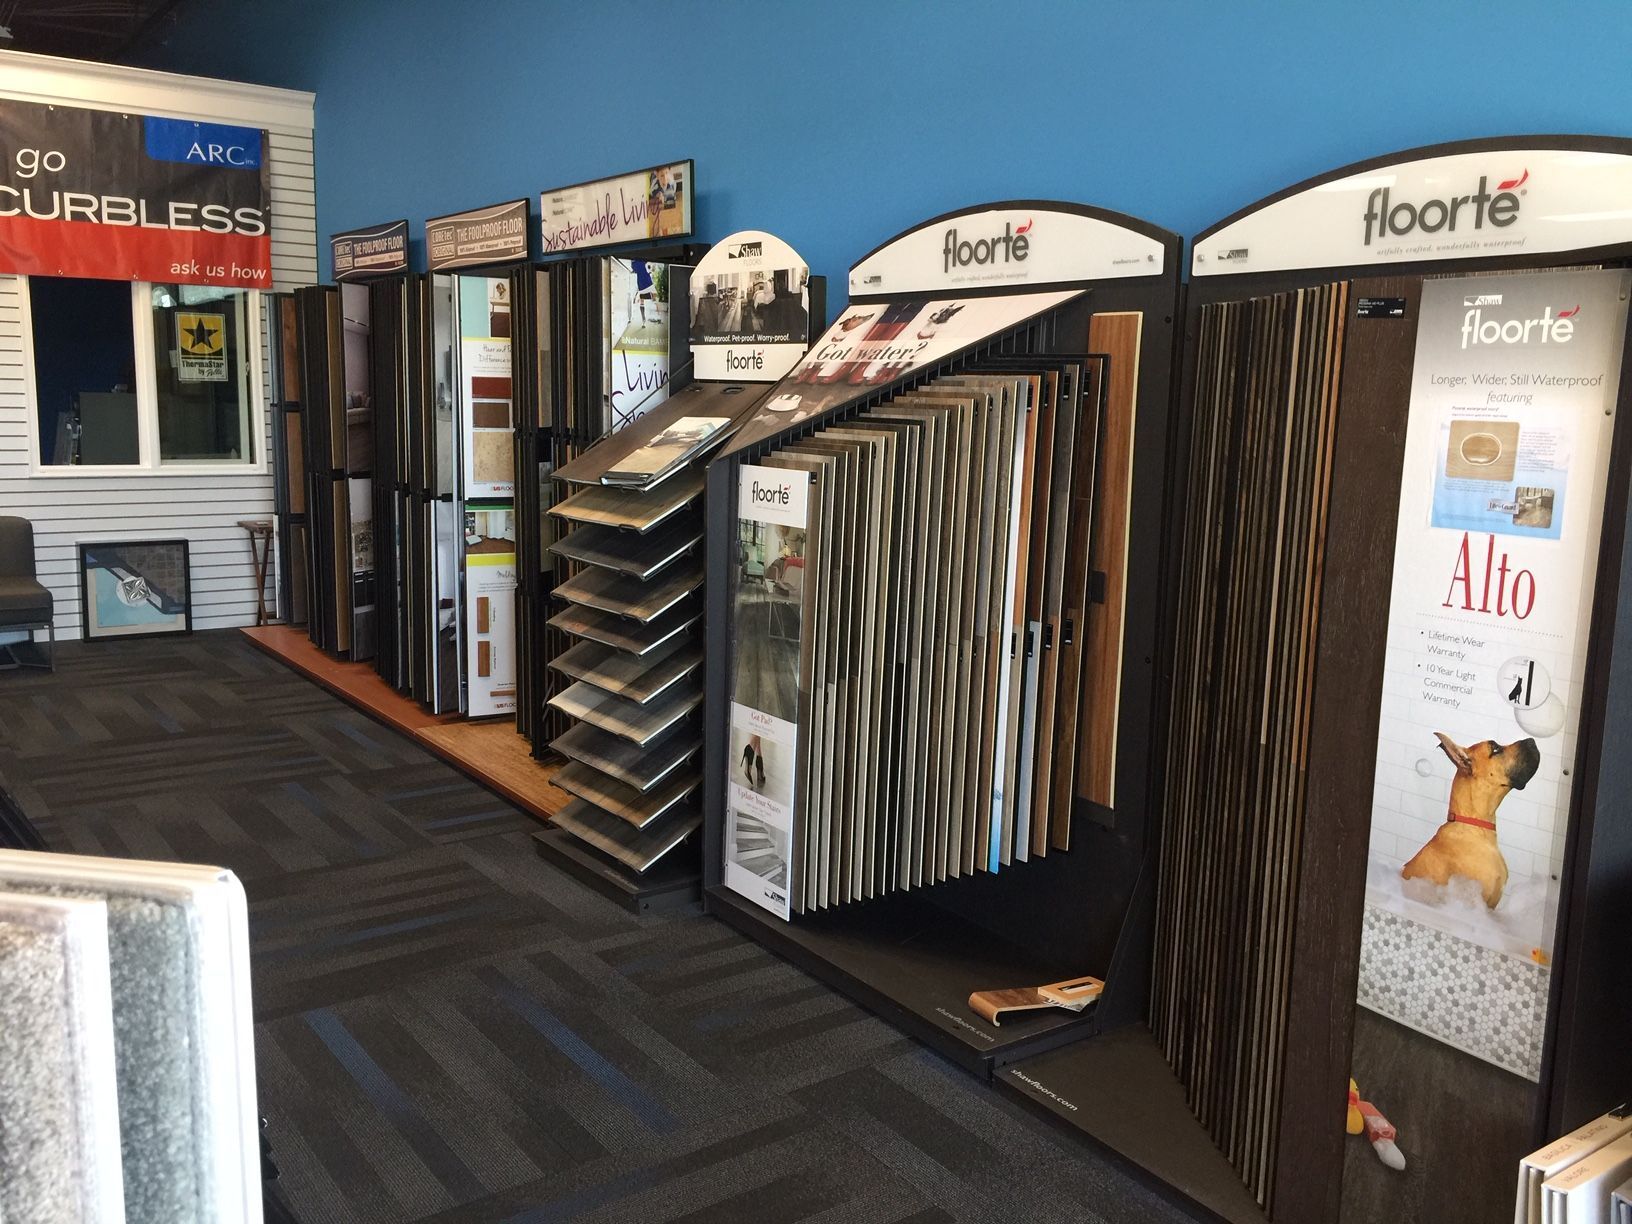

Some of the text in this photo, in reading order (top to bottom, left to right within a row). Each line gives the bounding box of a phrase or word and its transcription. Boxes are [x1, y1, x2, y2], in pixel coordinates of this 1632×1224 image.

[186, 142, 245, 166] ARC
[16, 148, 66, 179] go
[0, 185, 266, 237] CURBLESS
[542, 187, 664, 252] Sustainable Living
[456, 228, 468, 242] THE
[468, 221, 502, 240] FOOLPROOF
[502, 217, 523, 235] FLOOR
[353, 243, 362, 256] THE
[362, 238, 387, 254] FOOLPROOF
[387, 235, 403, 250] FLOOR
[741, 244, 762, 258] Shaw
[1484, 237, 1527, 248] waterproof
[170, 260, 267, 280] ask us how
[1478, 296, 1502, 306] Shaw
[704, 335, 731, 344] Waterproof.
[732, 335, 756, 343] Pet-proof.
[757, 333, 790, 342] Worry-proof.
[816, 341, 928, 361] Got water?
[181, 360, 224, 369] ThermaStar
[198, 368, 205, 376] by
[1431, 374, 1604, 388] Longer, Wider, Still Waterproof
[1486, 391, 1533, 405] featuring
[1442, 531, 1536, 620] Alto
[1428, 630, 1485, 648] Lifetime Wear
[1427, 645, 1465, 661] Warranty
[1426, 664, 1476, 682] 10 Year Light
[1423, 677, 1473, 695] Commercial
[1422, 691, 1460, 709] Warranty
[935, 1007, 995, 1043] shawfloors.com
[1010, 1069, 1078, 1112] shawfloors.com
